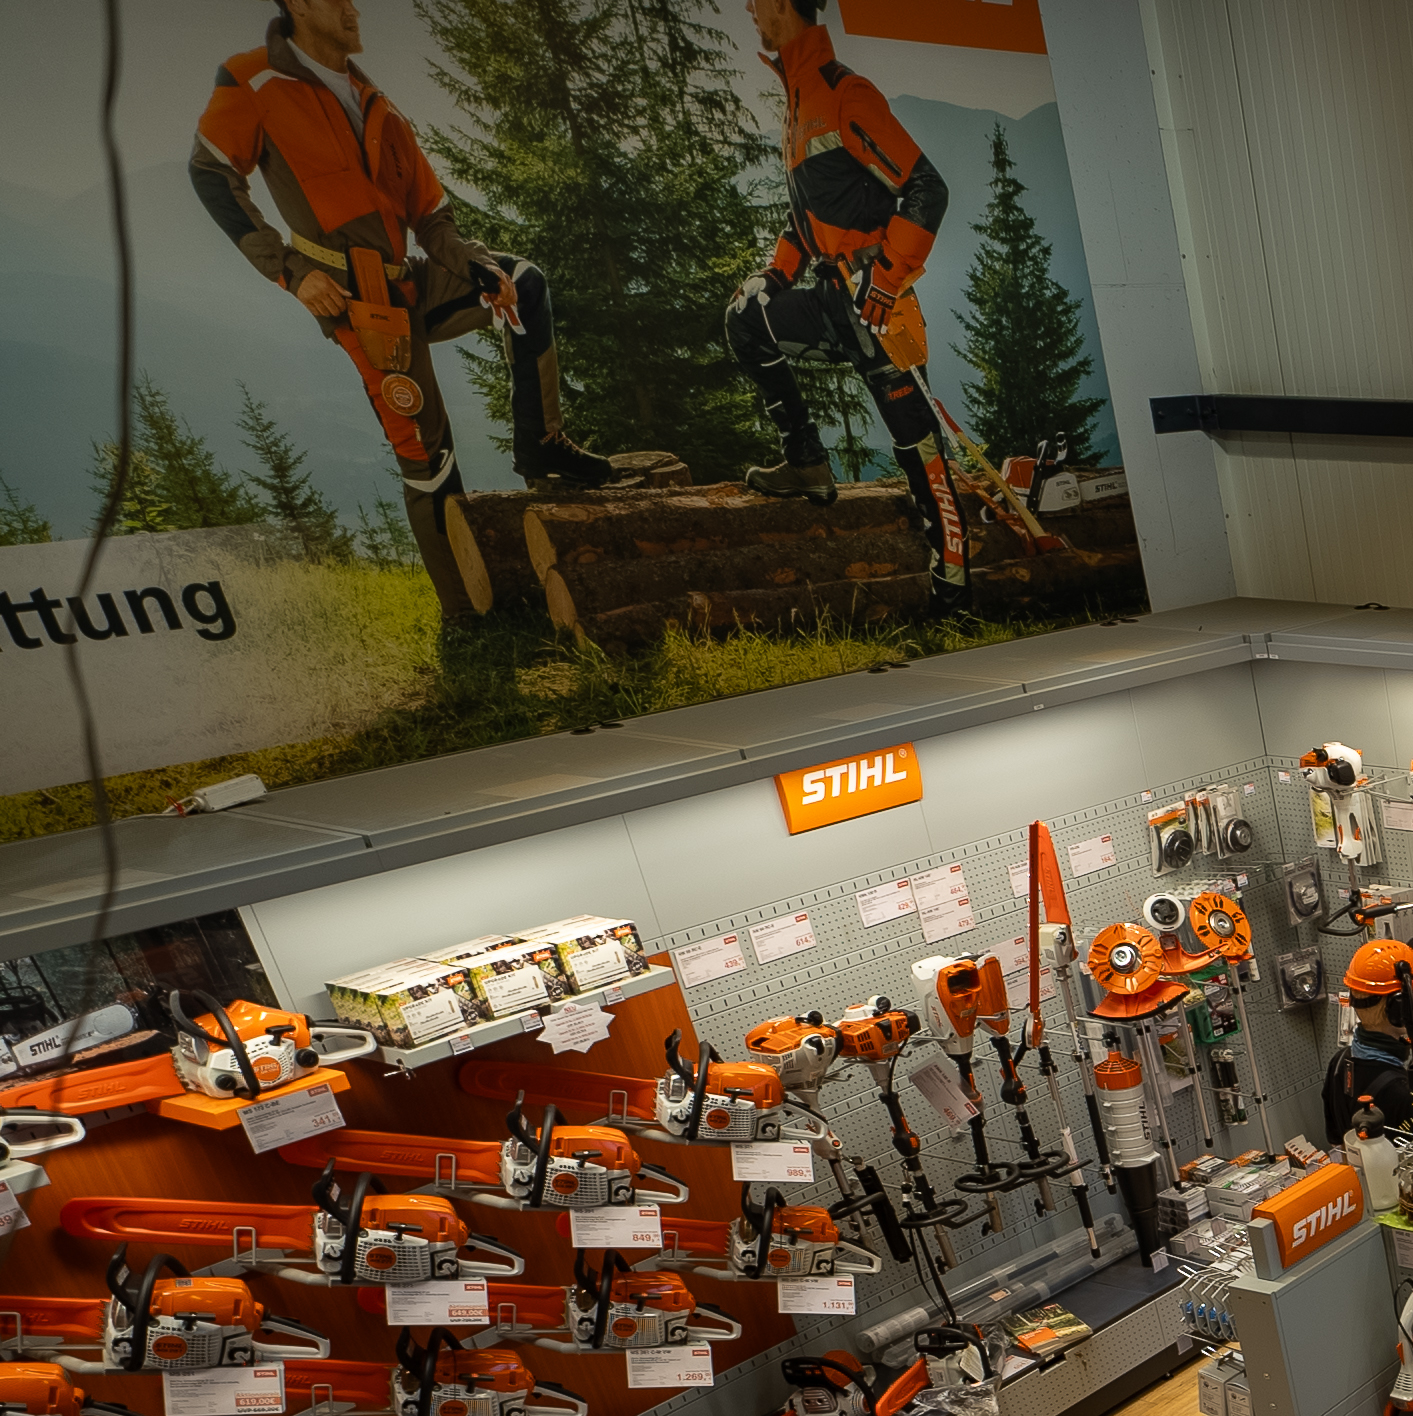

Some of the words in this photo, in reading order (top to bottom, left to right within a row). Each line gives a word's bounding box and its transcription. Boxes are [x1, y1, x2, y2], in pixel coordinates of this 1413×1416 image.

[932, 473, 963, 555] STIHL
[801, 752, 908, 806] STIHL
[29, 1035, 62, 1057] STIHL
[78, 1081, 126, 1100] STIHL
[1138, 1099, 1151, 1141] STIHL
[380, 1150, 424, 1163] STIHL
[180, 1219, 231, 1232] STIHL
[1291, 1197, 1357, 1249] STIHL
